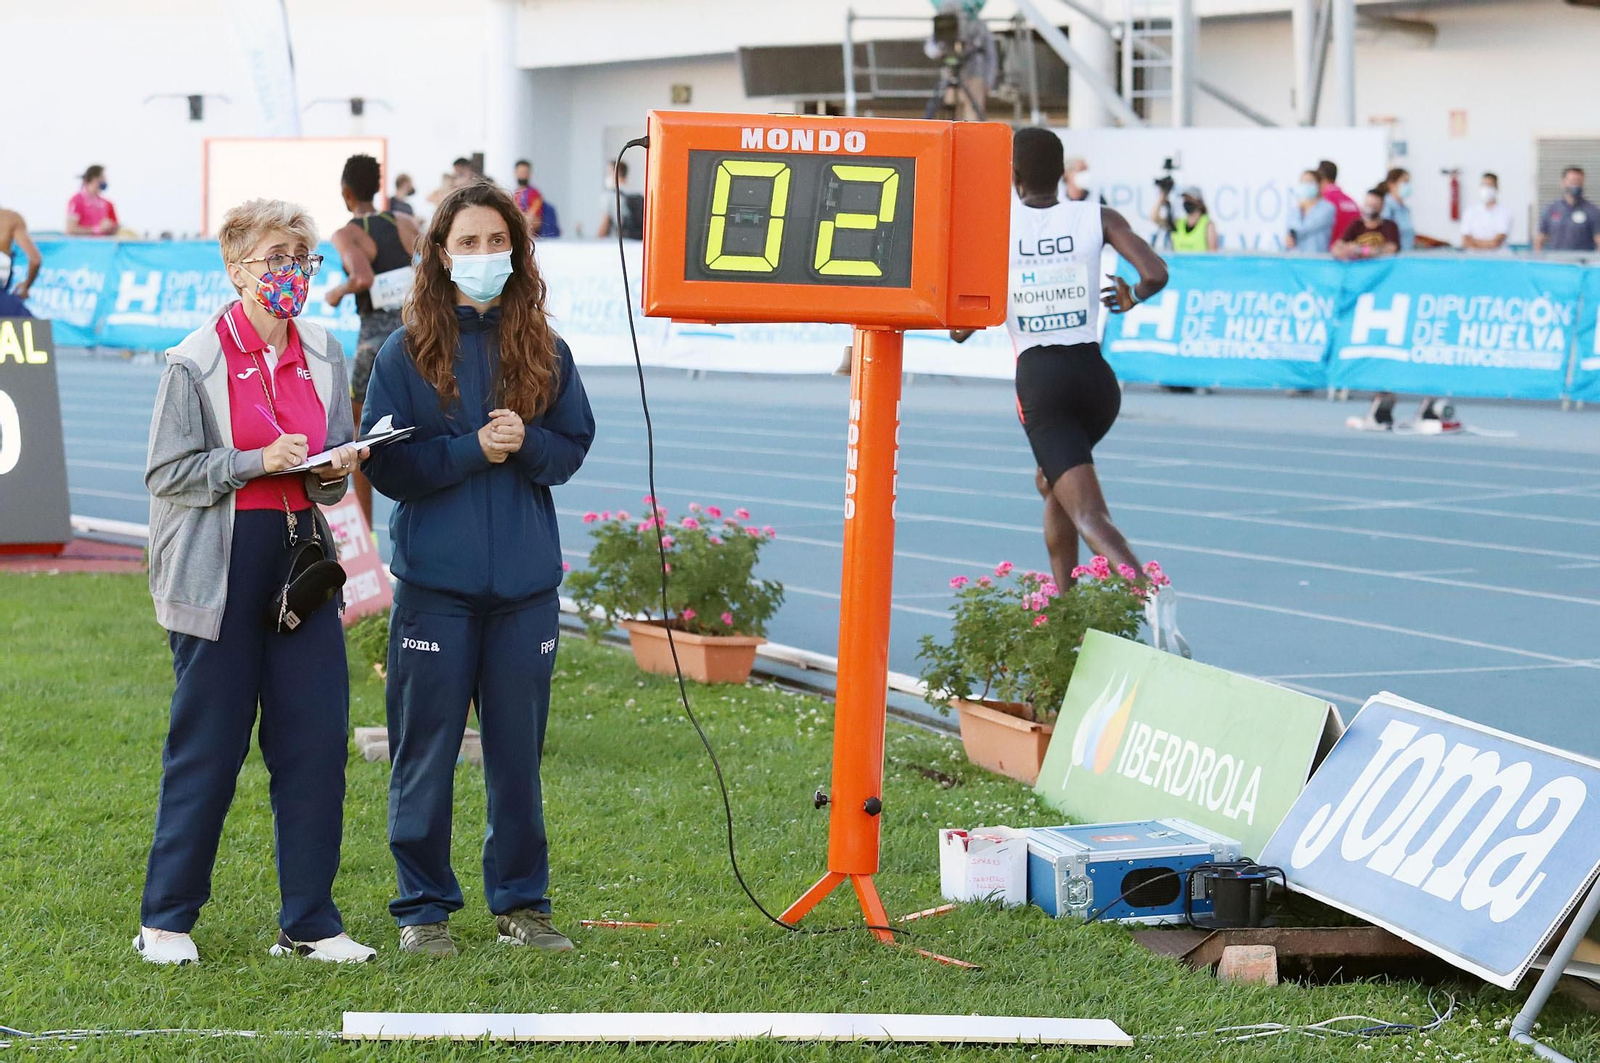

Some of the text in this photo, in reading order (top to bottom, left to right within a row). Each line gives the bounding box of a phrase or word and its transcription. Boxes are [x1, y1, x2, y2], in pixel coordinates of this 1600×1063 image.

[741, 127, 867, 153] MONDO
[705, 160, 900, 277] 02
[1019, 235, 1074, 256] LGO
[1013, 286, 1086, 304] MOHUMED
[1185, 286, 1334, 320] DIPUTACIÓN
[1416, 291, 1573, 327] DIPUTACIÓN
[1181, 315, 1328, 346] DE HUELVA
[1412, 320, 1449, 347] DE
[1457, 321, 1566, 351] HUELVA
[844, 399, 861, 520] MONDO
[1116, 721, 1262, 826] IBERDROLA
